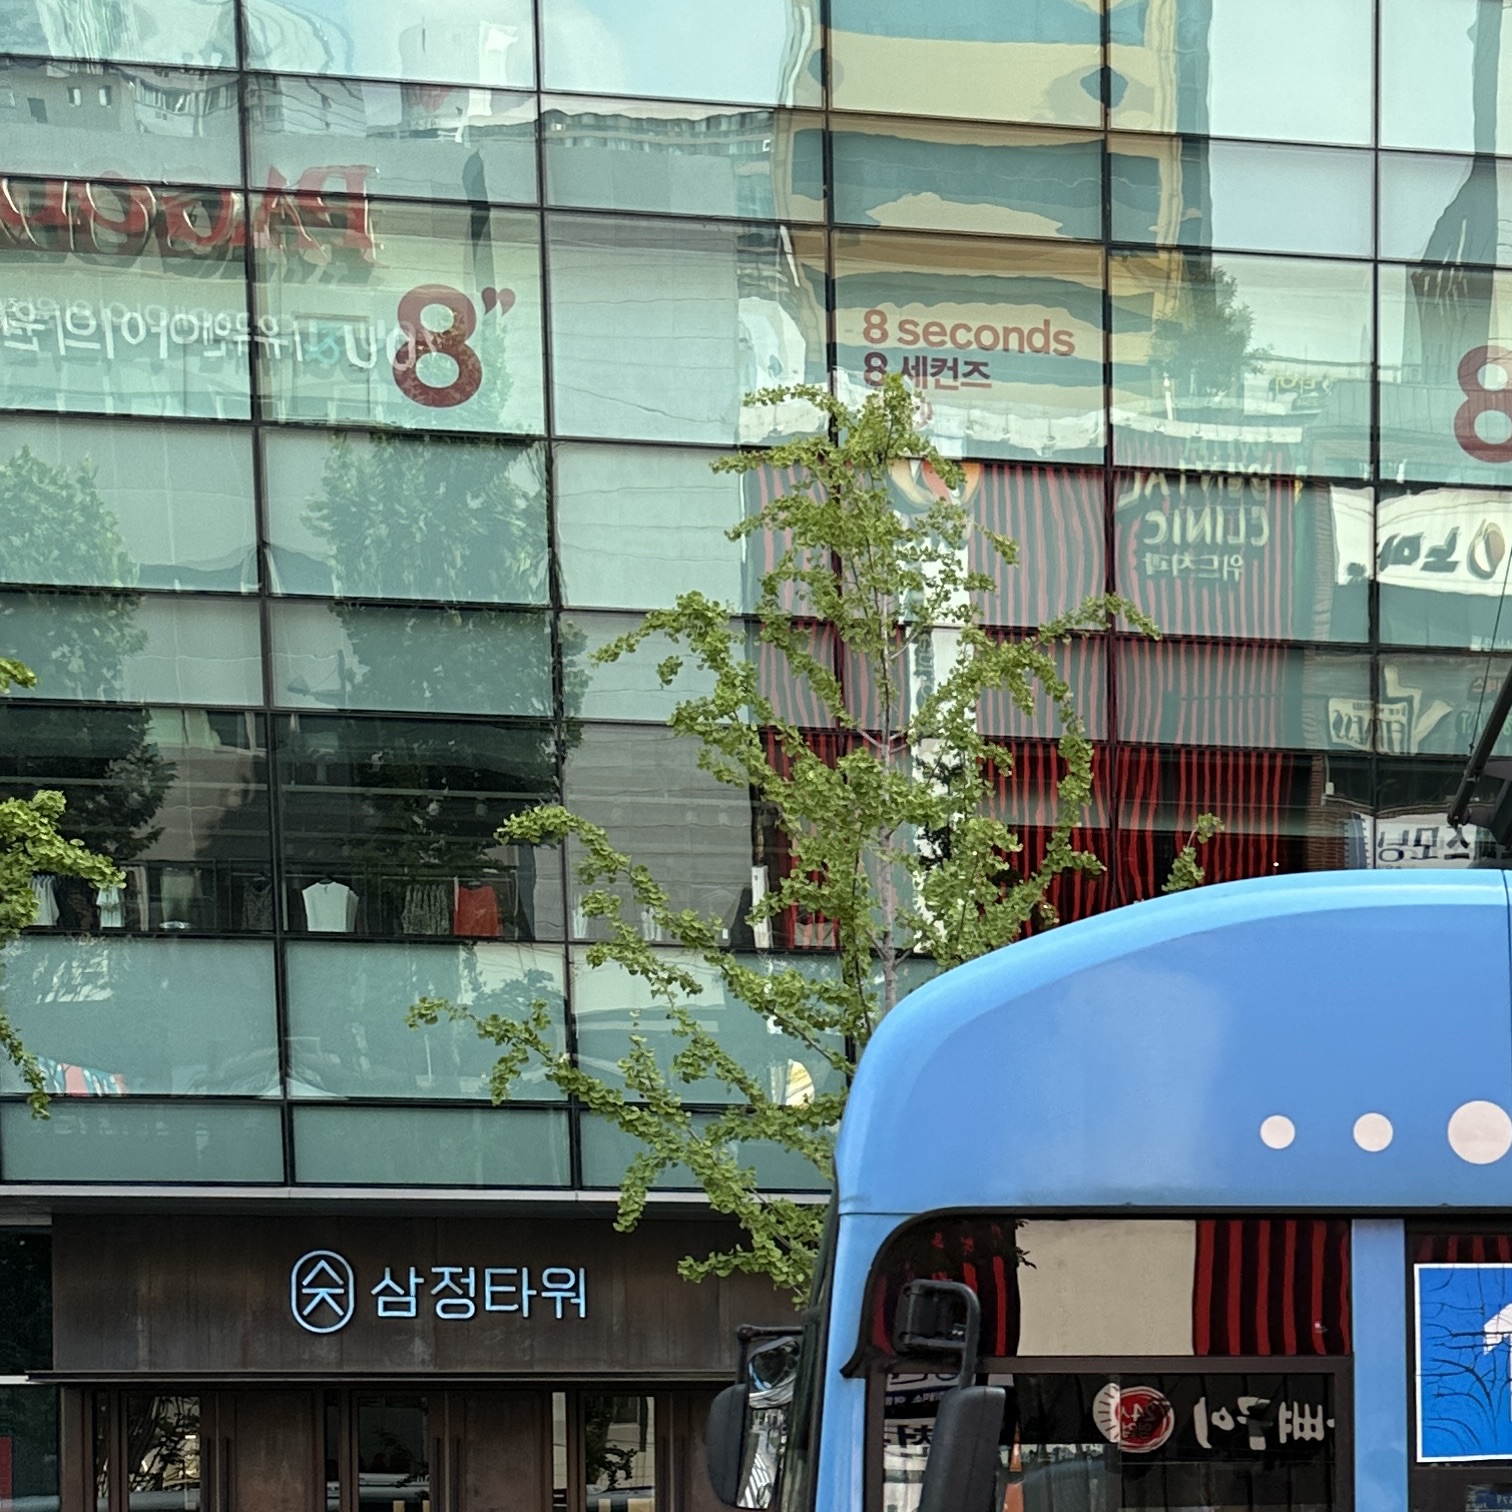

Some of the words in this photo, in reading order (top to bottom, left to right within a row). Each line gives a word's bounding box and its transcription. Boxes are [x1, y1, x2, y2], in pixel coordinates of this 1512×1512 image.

[863, 309, 889, 345] 8
[896, 318, 1076, 357] seconds
[863, 352, 889, 388] 8
[900, 355, 992, 391] 세컨즈
[370, 1265, 588, 1320] 삼정타워
